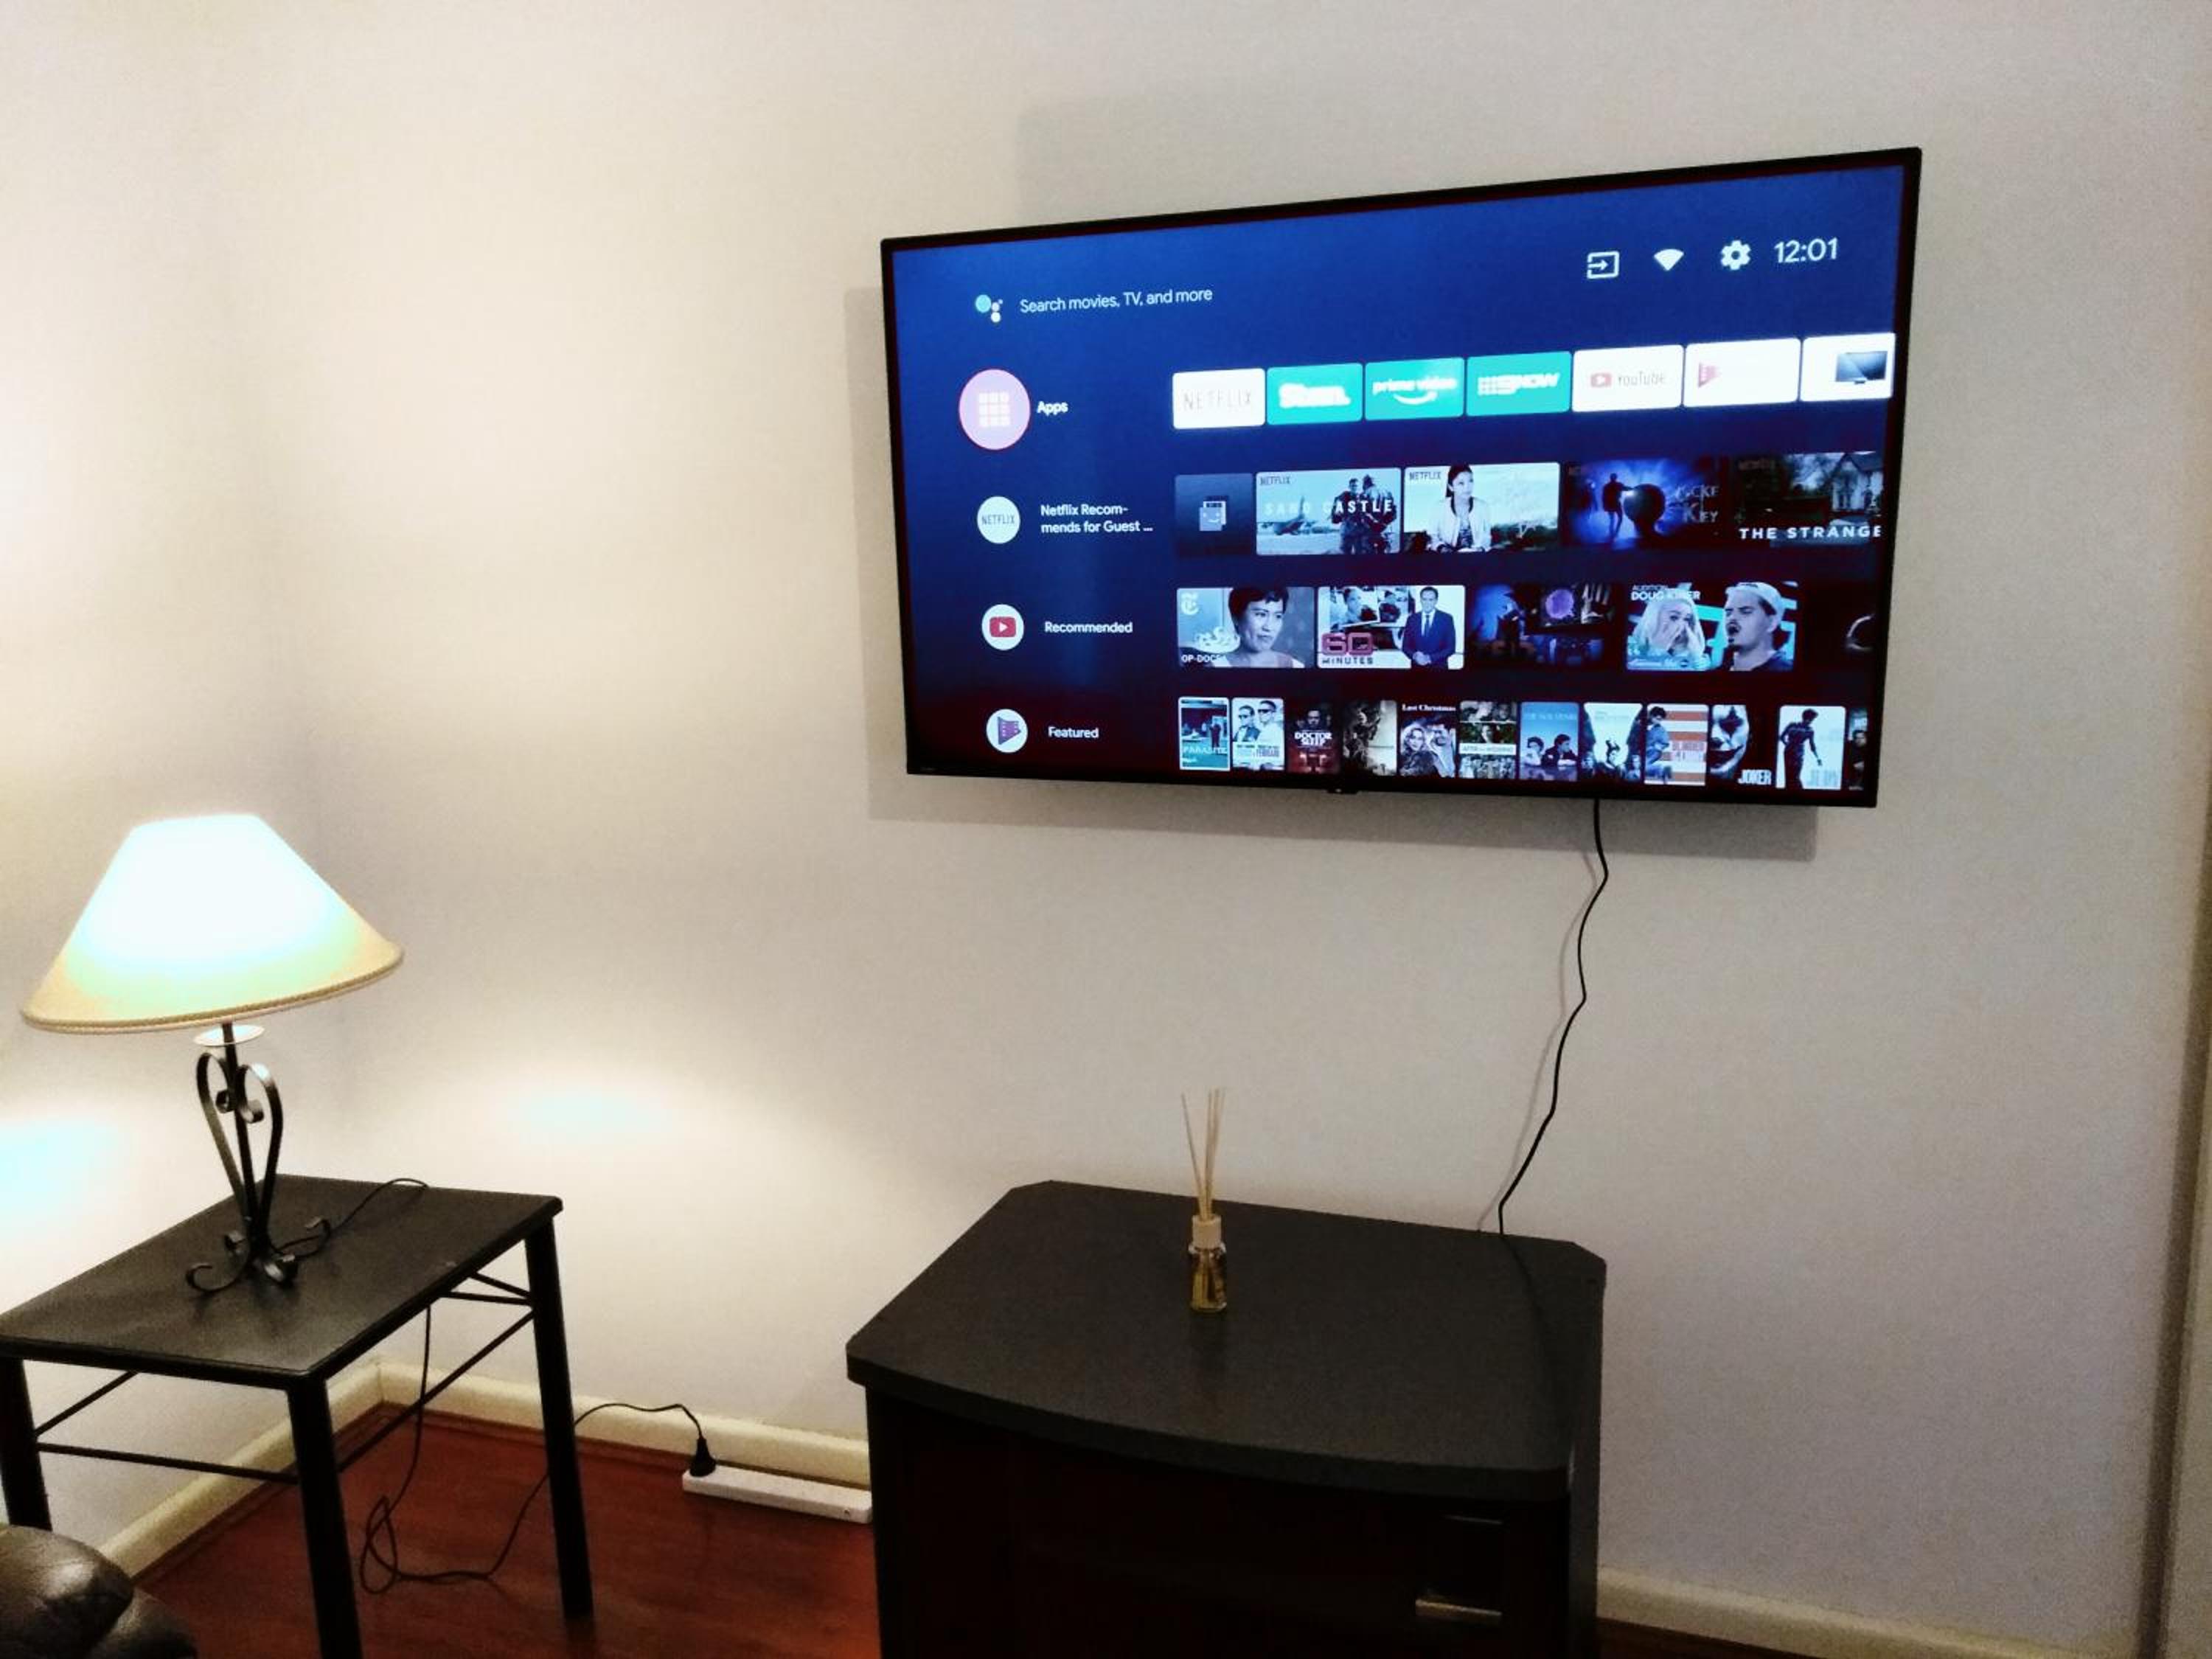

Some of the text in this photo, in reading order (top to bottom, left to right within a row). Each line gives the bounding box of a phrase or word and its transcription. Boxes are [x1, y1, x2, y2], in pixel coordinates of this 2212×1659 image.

[1774, 237, 1837, 263] 12:01
[1020, 288, 1213, 313] Search movies, TV, and more
[1037, 400, 1068, 416] Apps
[1409, 471, 1441, 481] NETFLIX
[1040, 504, 1129, 517] Netflix Recom-
[1322, 498, 1393, 515] CASTLE
[981, 515, 1015, 526] NETFLIX
[1040, 521, 1081, 533] mends
[1083, 521, 1101, 532] for
[1103, 520, 1140, 532] Guest
[1739, 526, 1777, 540] THE
[1045, 621, 1133, 633] Recommended
[1321, 632, 1374, 655] 60
[1048, 726, 1099, 738] Featured
[1294, 731, 1332, 740] DOCTOR
[1738, 769, 1772, 785] JOKER
